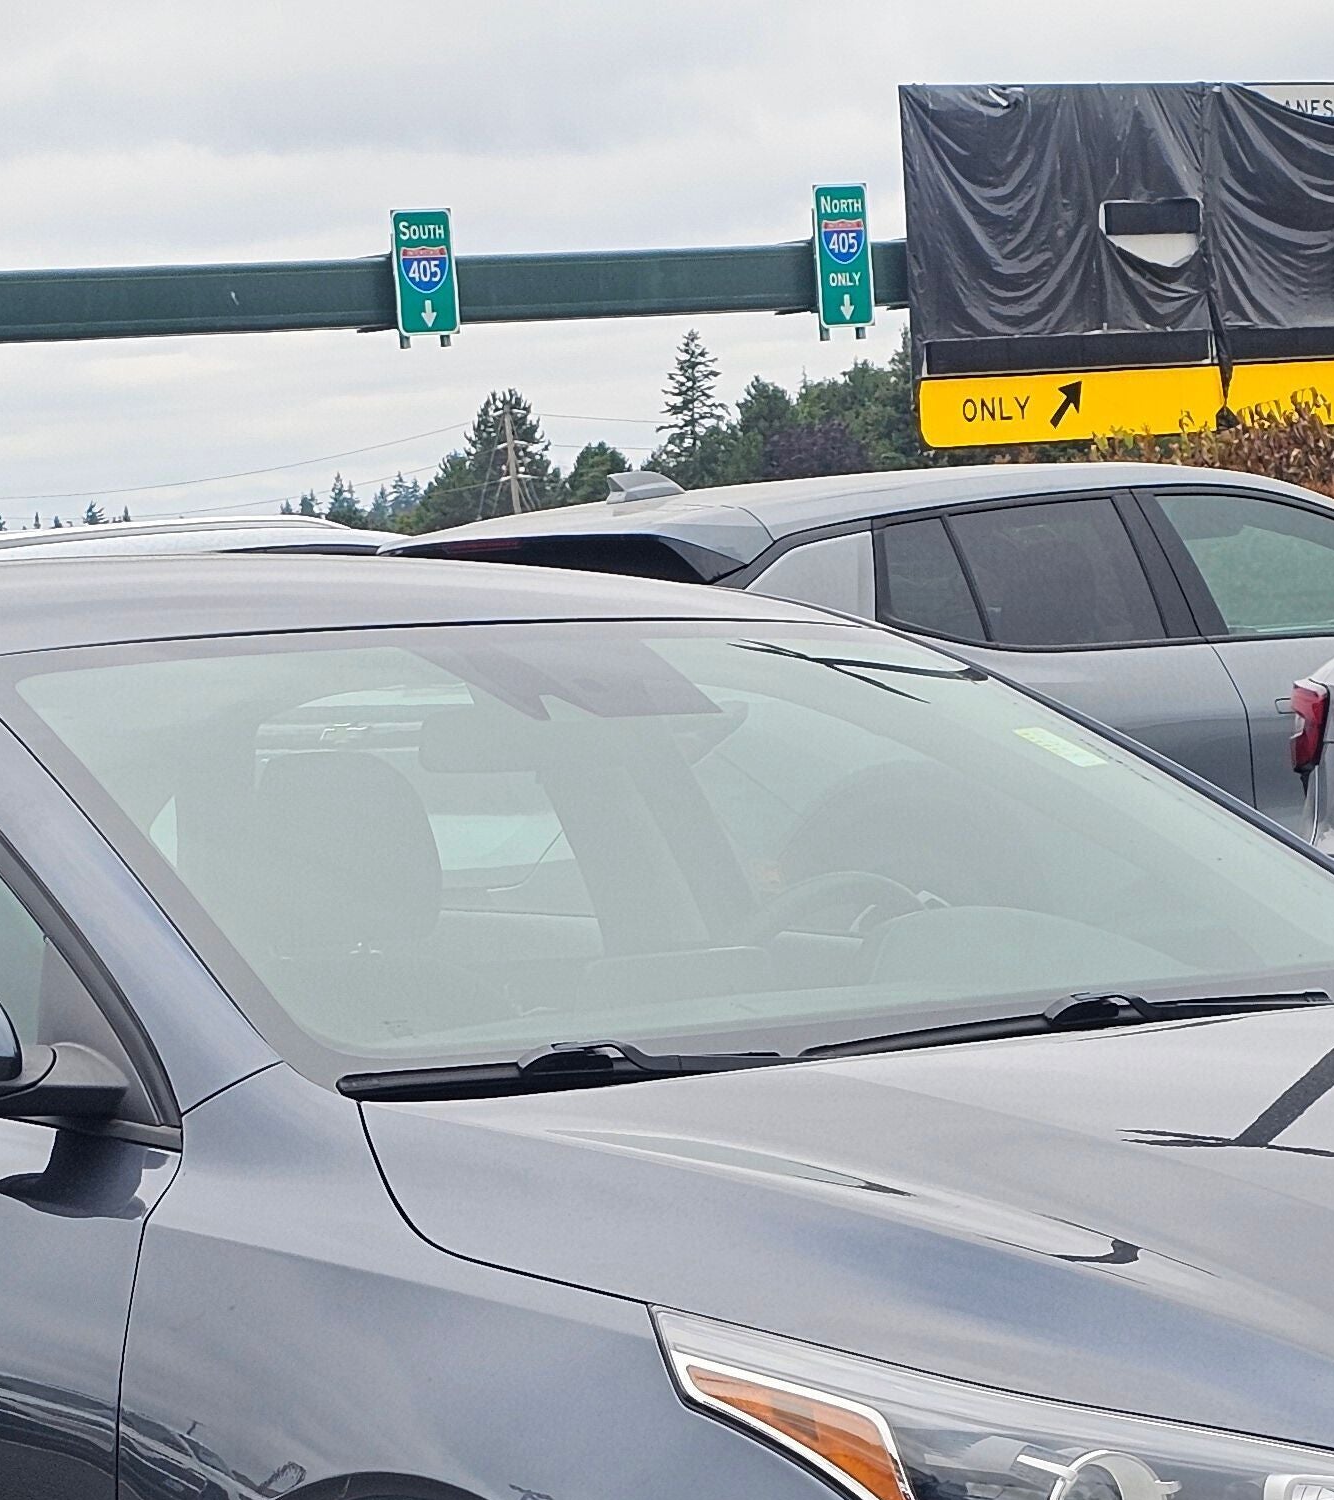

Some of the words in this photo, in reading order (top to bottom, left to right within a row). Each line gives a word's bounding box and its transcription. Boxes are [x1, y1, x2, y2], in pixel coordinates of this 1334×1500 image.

[820, 195, 863, 215] NORTH
[398, 220, 445, 241] SOUTH
[829, 232, 858, 254] 405
[408, 260, 441, 283] 405
[829, 271, 861, 287] ONLY
[962, 395, 1031, 423] ONLY
